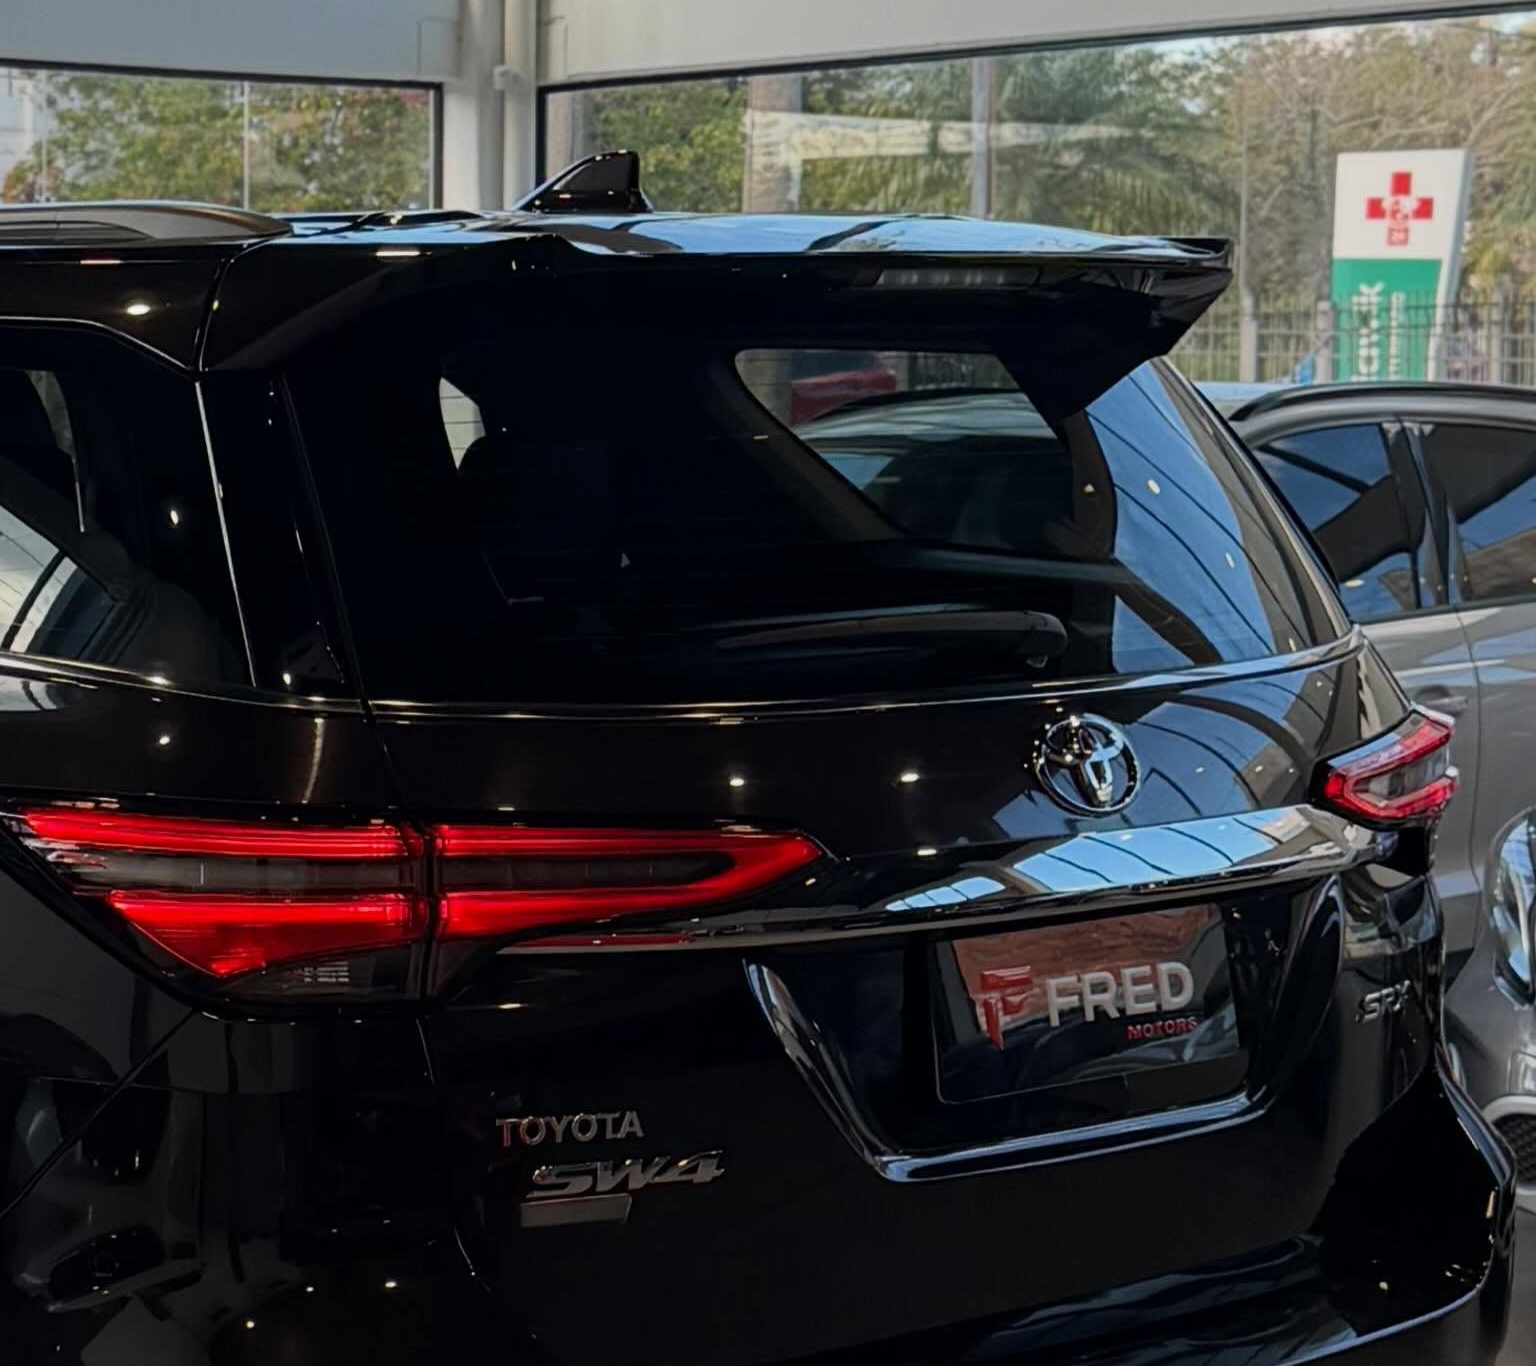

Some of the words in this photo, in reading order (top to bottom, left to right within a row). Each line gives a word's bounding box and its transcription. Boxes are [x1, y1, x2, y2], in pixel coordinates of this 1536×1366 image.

[1045, 962, 1194, 1028] FRED
[1356, 979, 1411, 1024] SRX
[1127, 1017, 1198, 1040] MOTORS
[496, 1111, 644, 1147] TOYOTA
[526, 1149, 725, 1199] SW4
